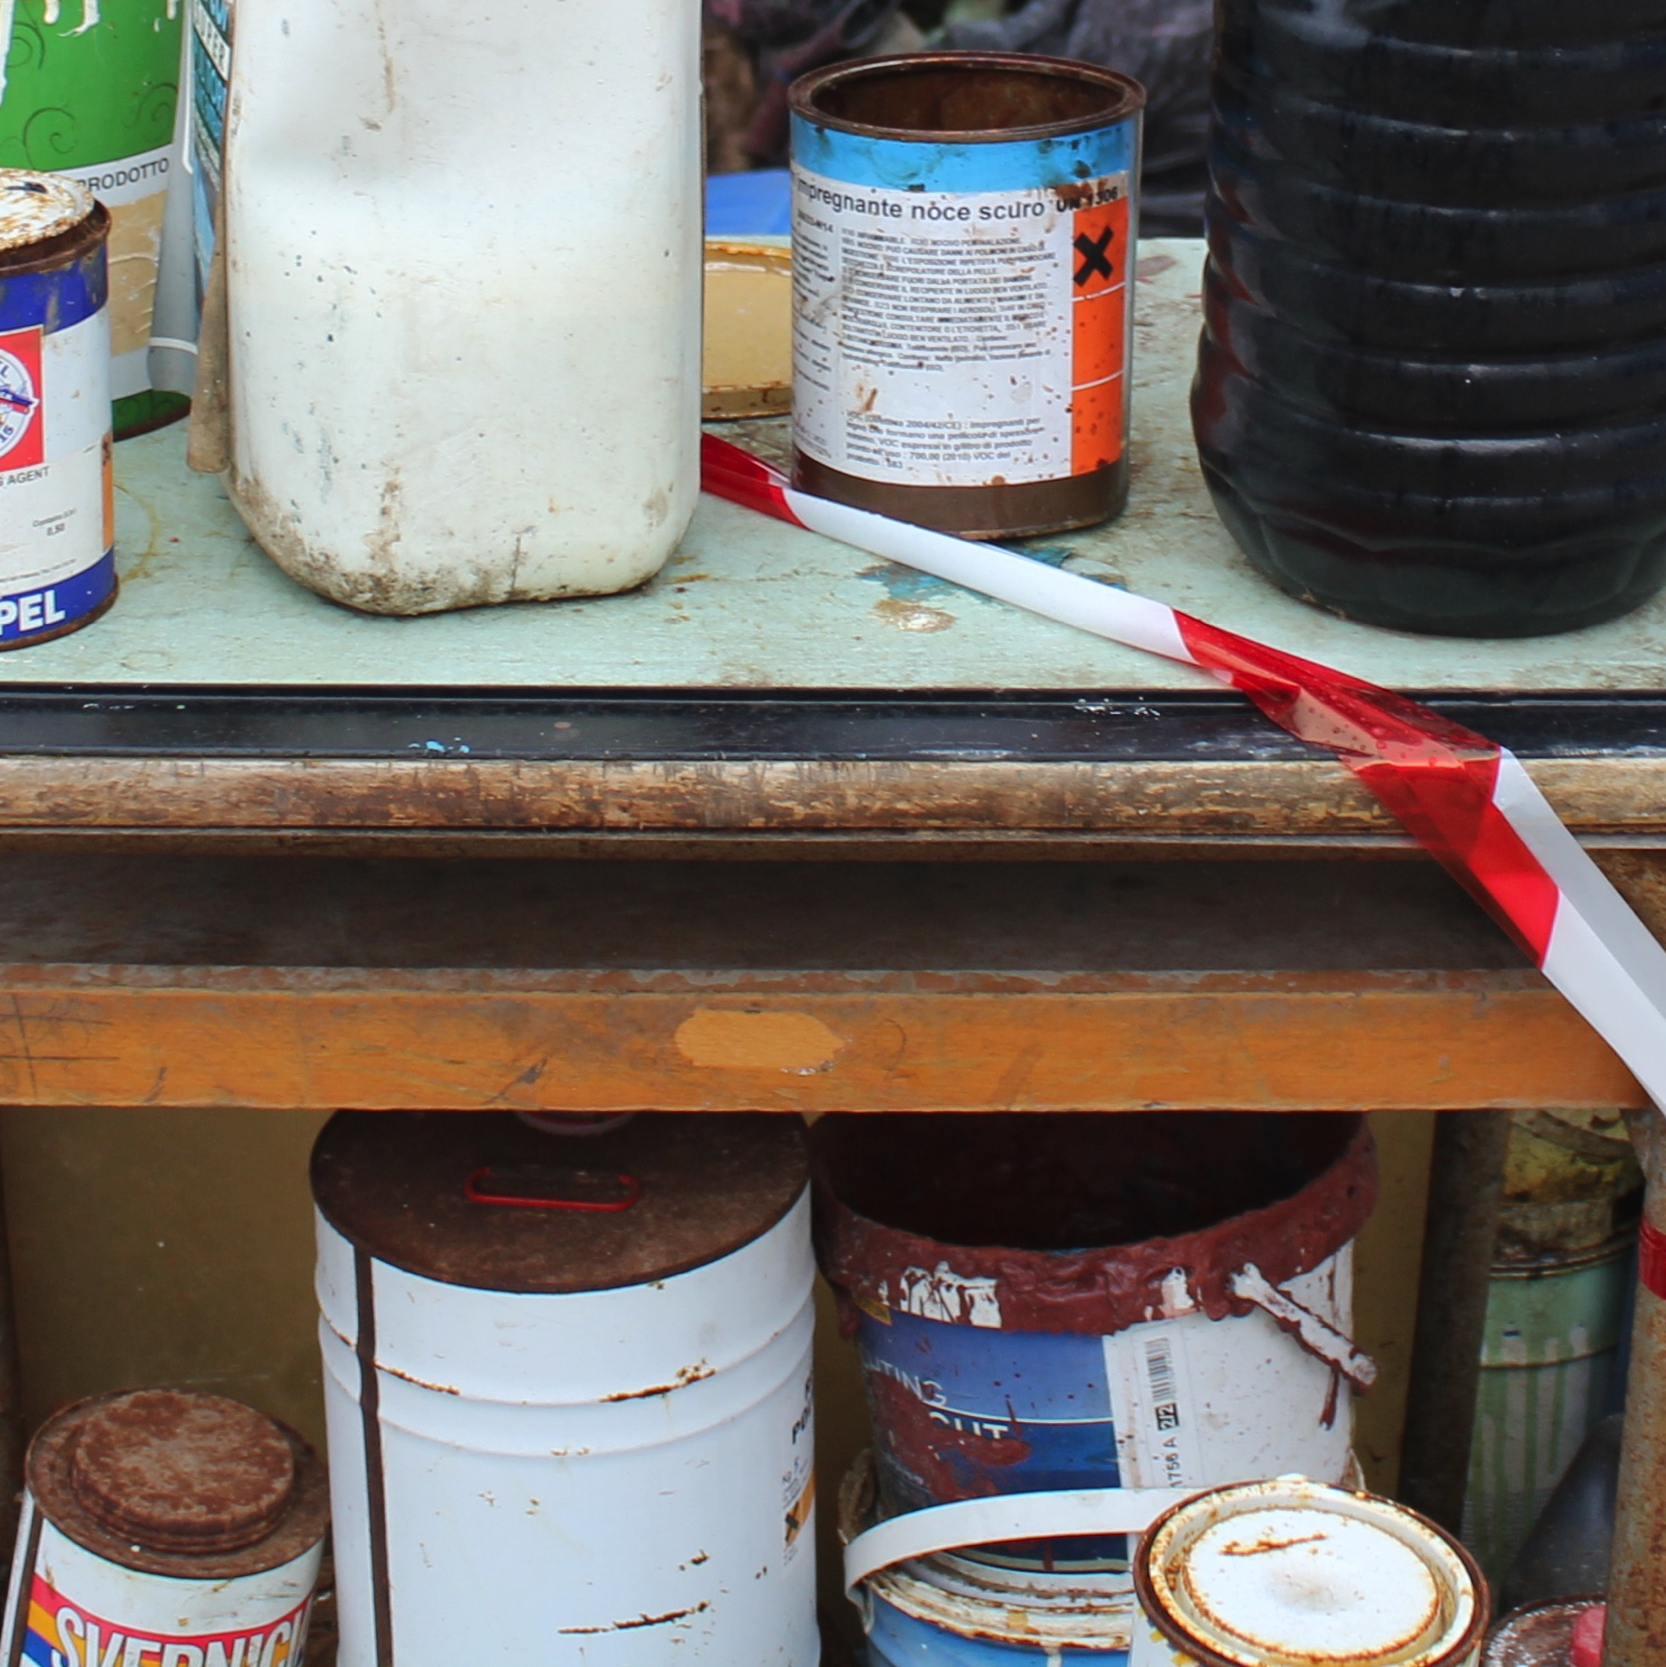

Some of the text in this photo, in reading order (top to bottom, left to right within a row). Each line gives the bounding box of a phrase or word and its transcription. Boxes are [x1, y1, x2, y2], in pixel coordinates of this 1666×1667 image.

[911, 204, 971, 221] noce
[978, 200, 1045, 220] scuro
[7, 466, 50, 485] AGENT
